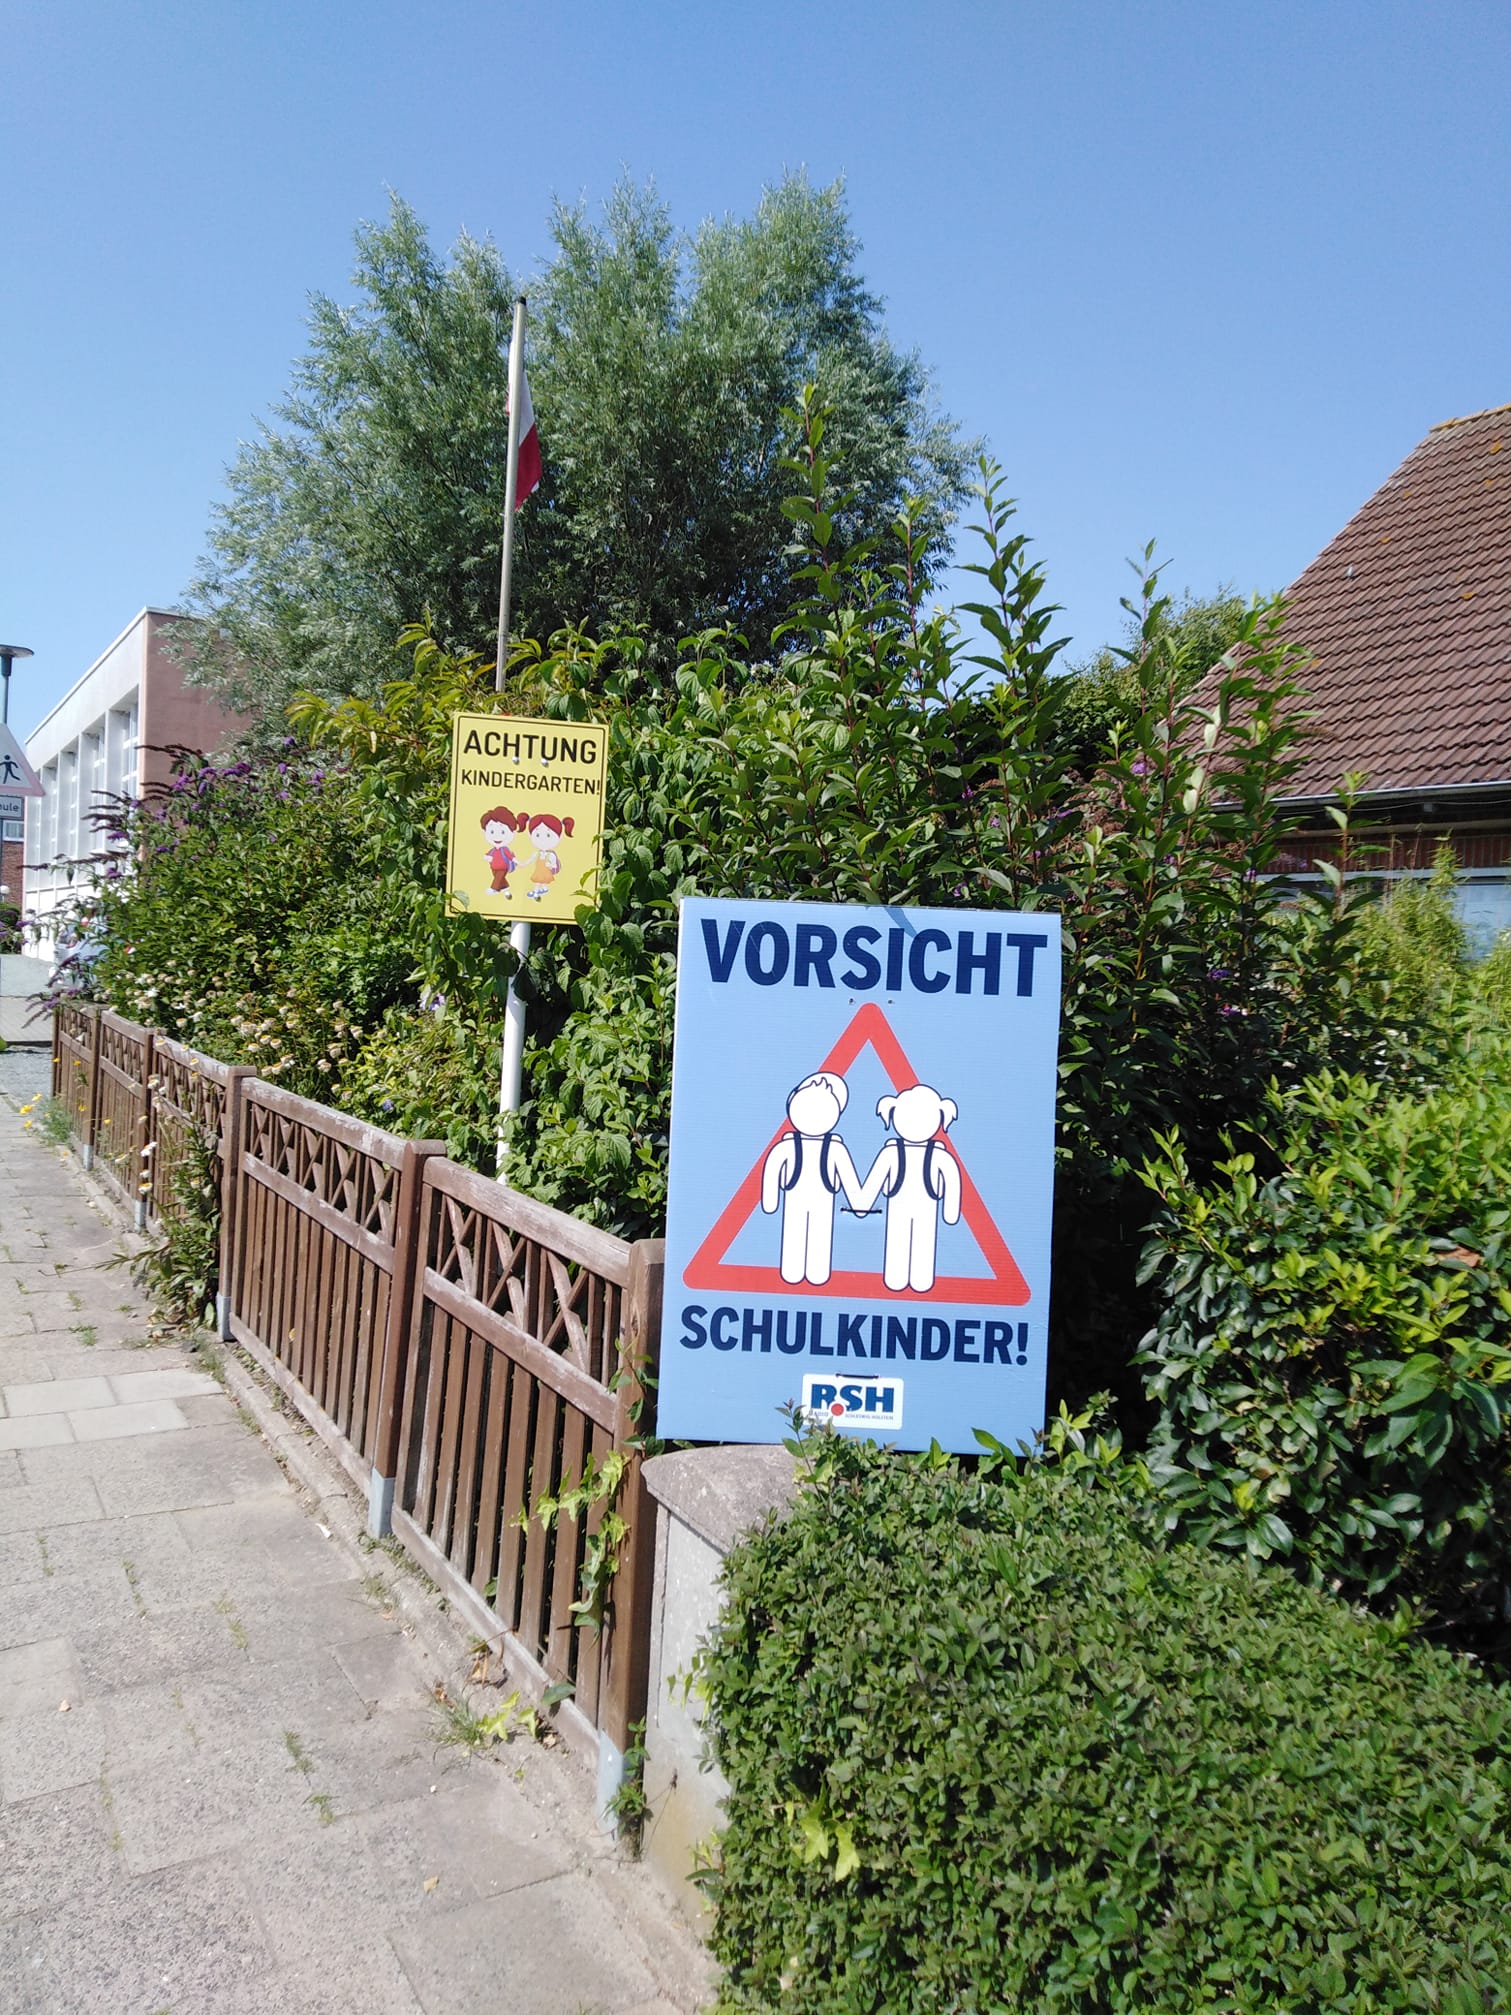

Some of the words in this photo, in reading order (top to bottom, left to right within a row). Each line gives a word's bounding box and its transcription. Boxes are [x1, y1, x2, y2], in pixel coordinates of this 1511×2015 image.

[463, 730, 597, 764] ACHTUNG
[462, 769, 600, 796] KINDERGARTEN!
[700, 918, 1049, 997] VORSICHT
[679, 1305, 1029, 1366] SCHULKINDER!
